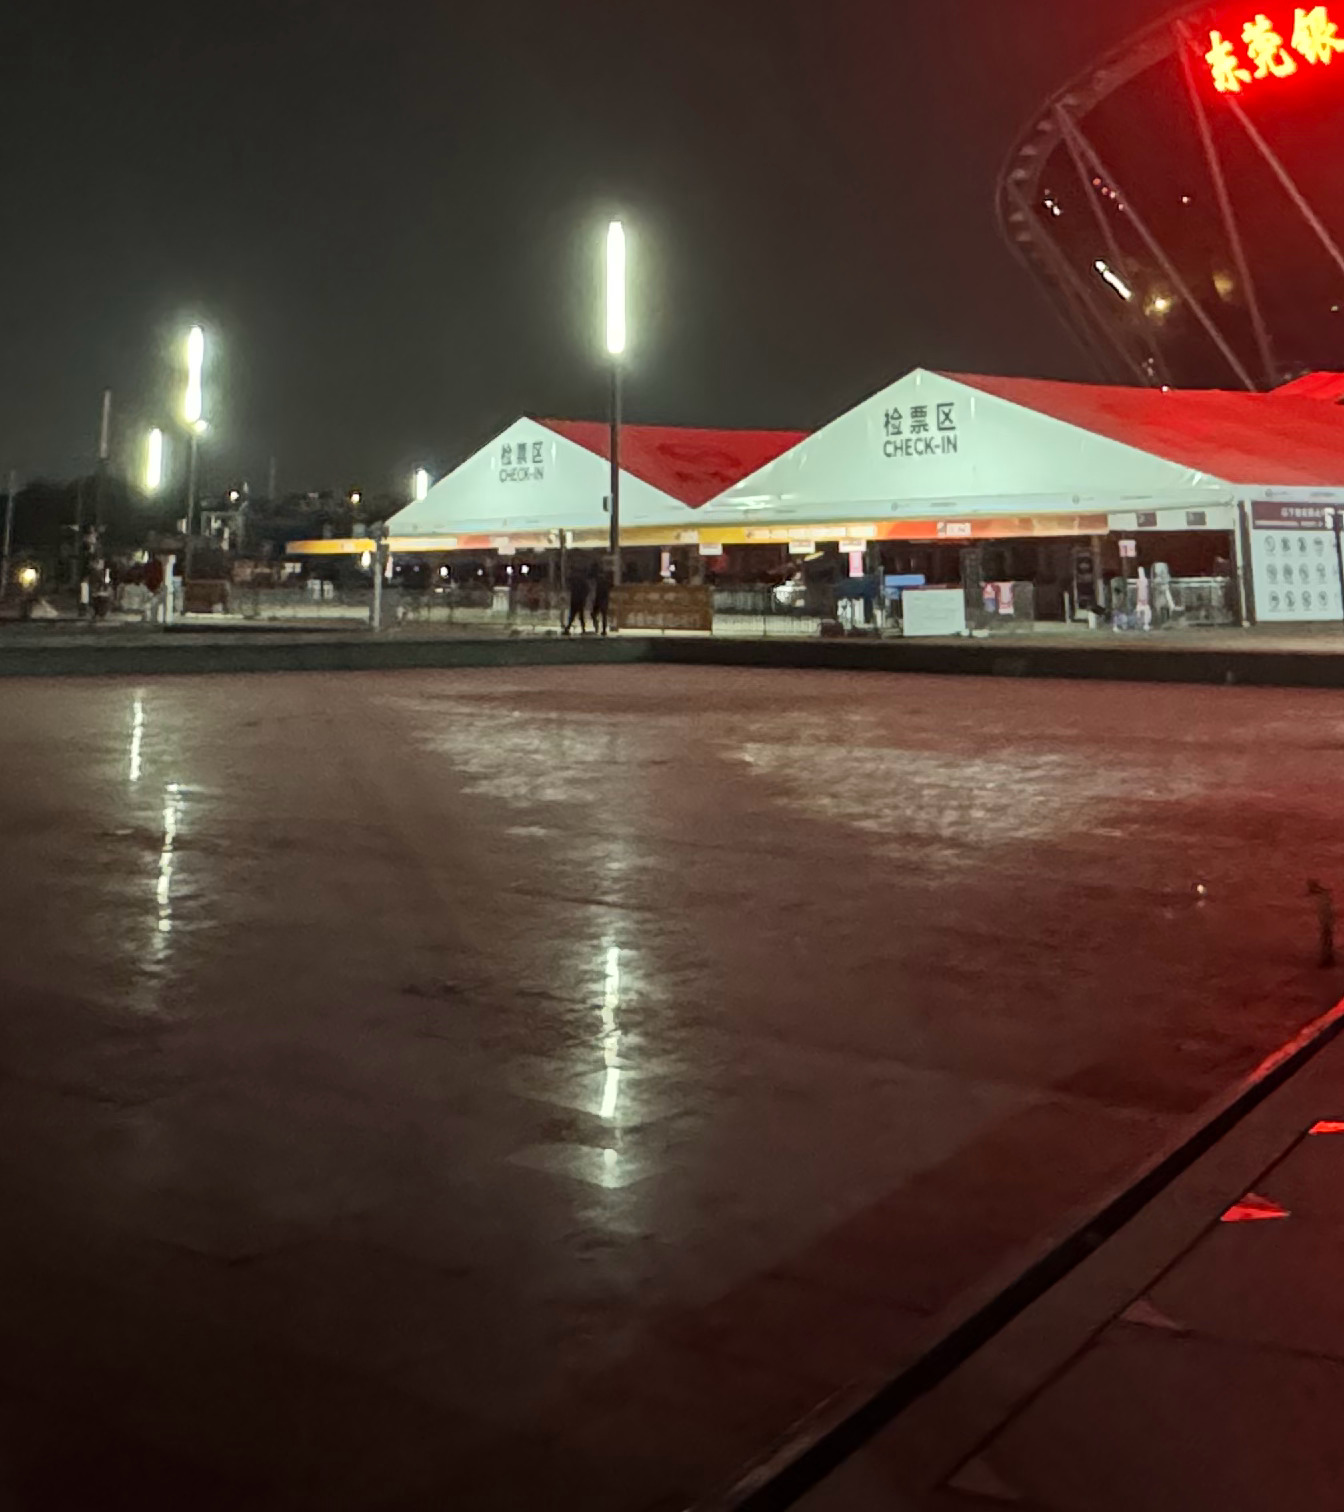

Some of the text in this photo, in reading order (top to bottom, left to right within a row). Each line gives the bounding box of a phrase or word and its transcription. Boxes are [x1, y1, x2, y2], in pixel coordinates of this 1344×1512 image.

[883, 402, 956, 437] 检票区
[501, 441, 544, 465] 检票区
[883, 434, 958, 458] CHECK-IN
